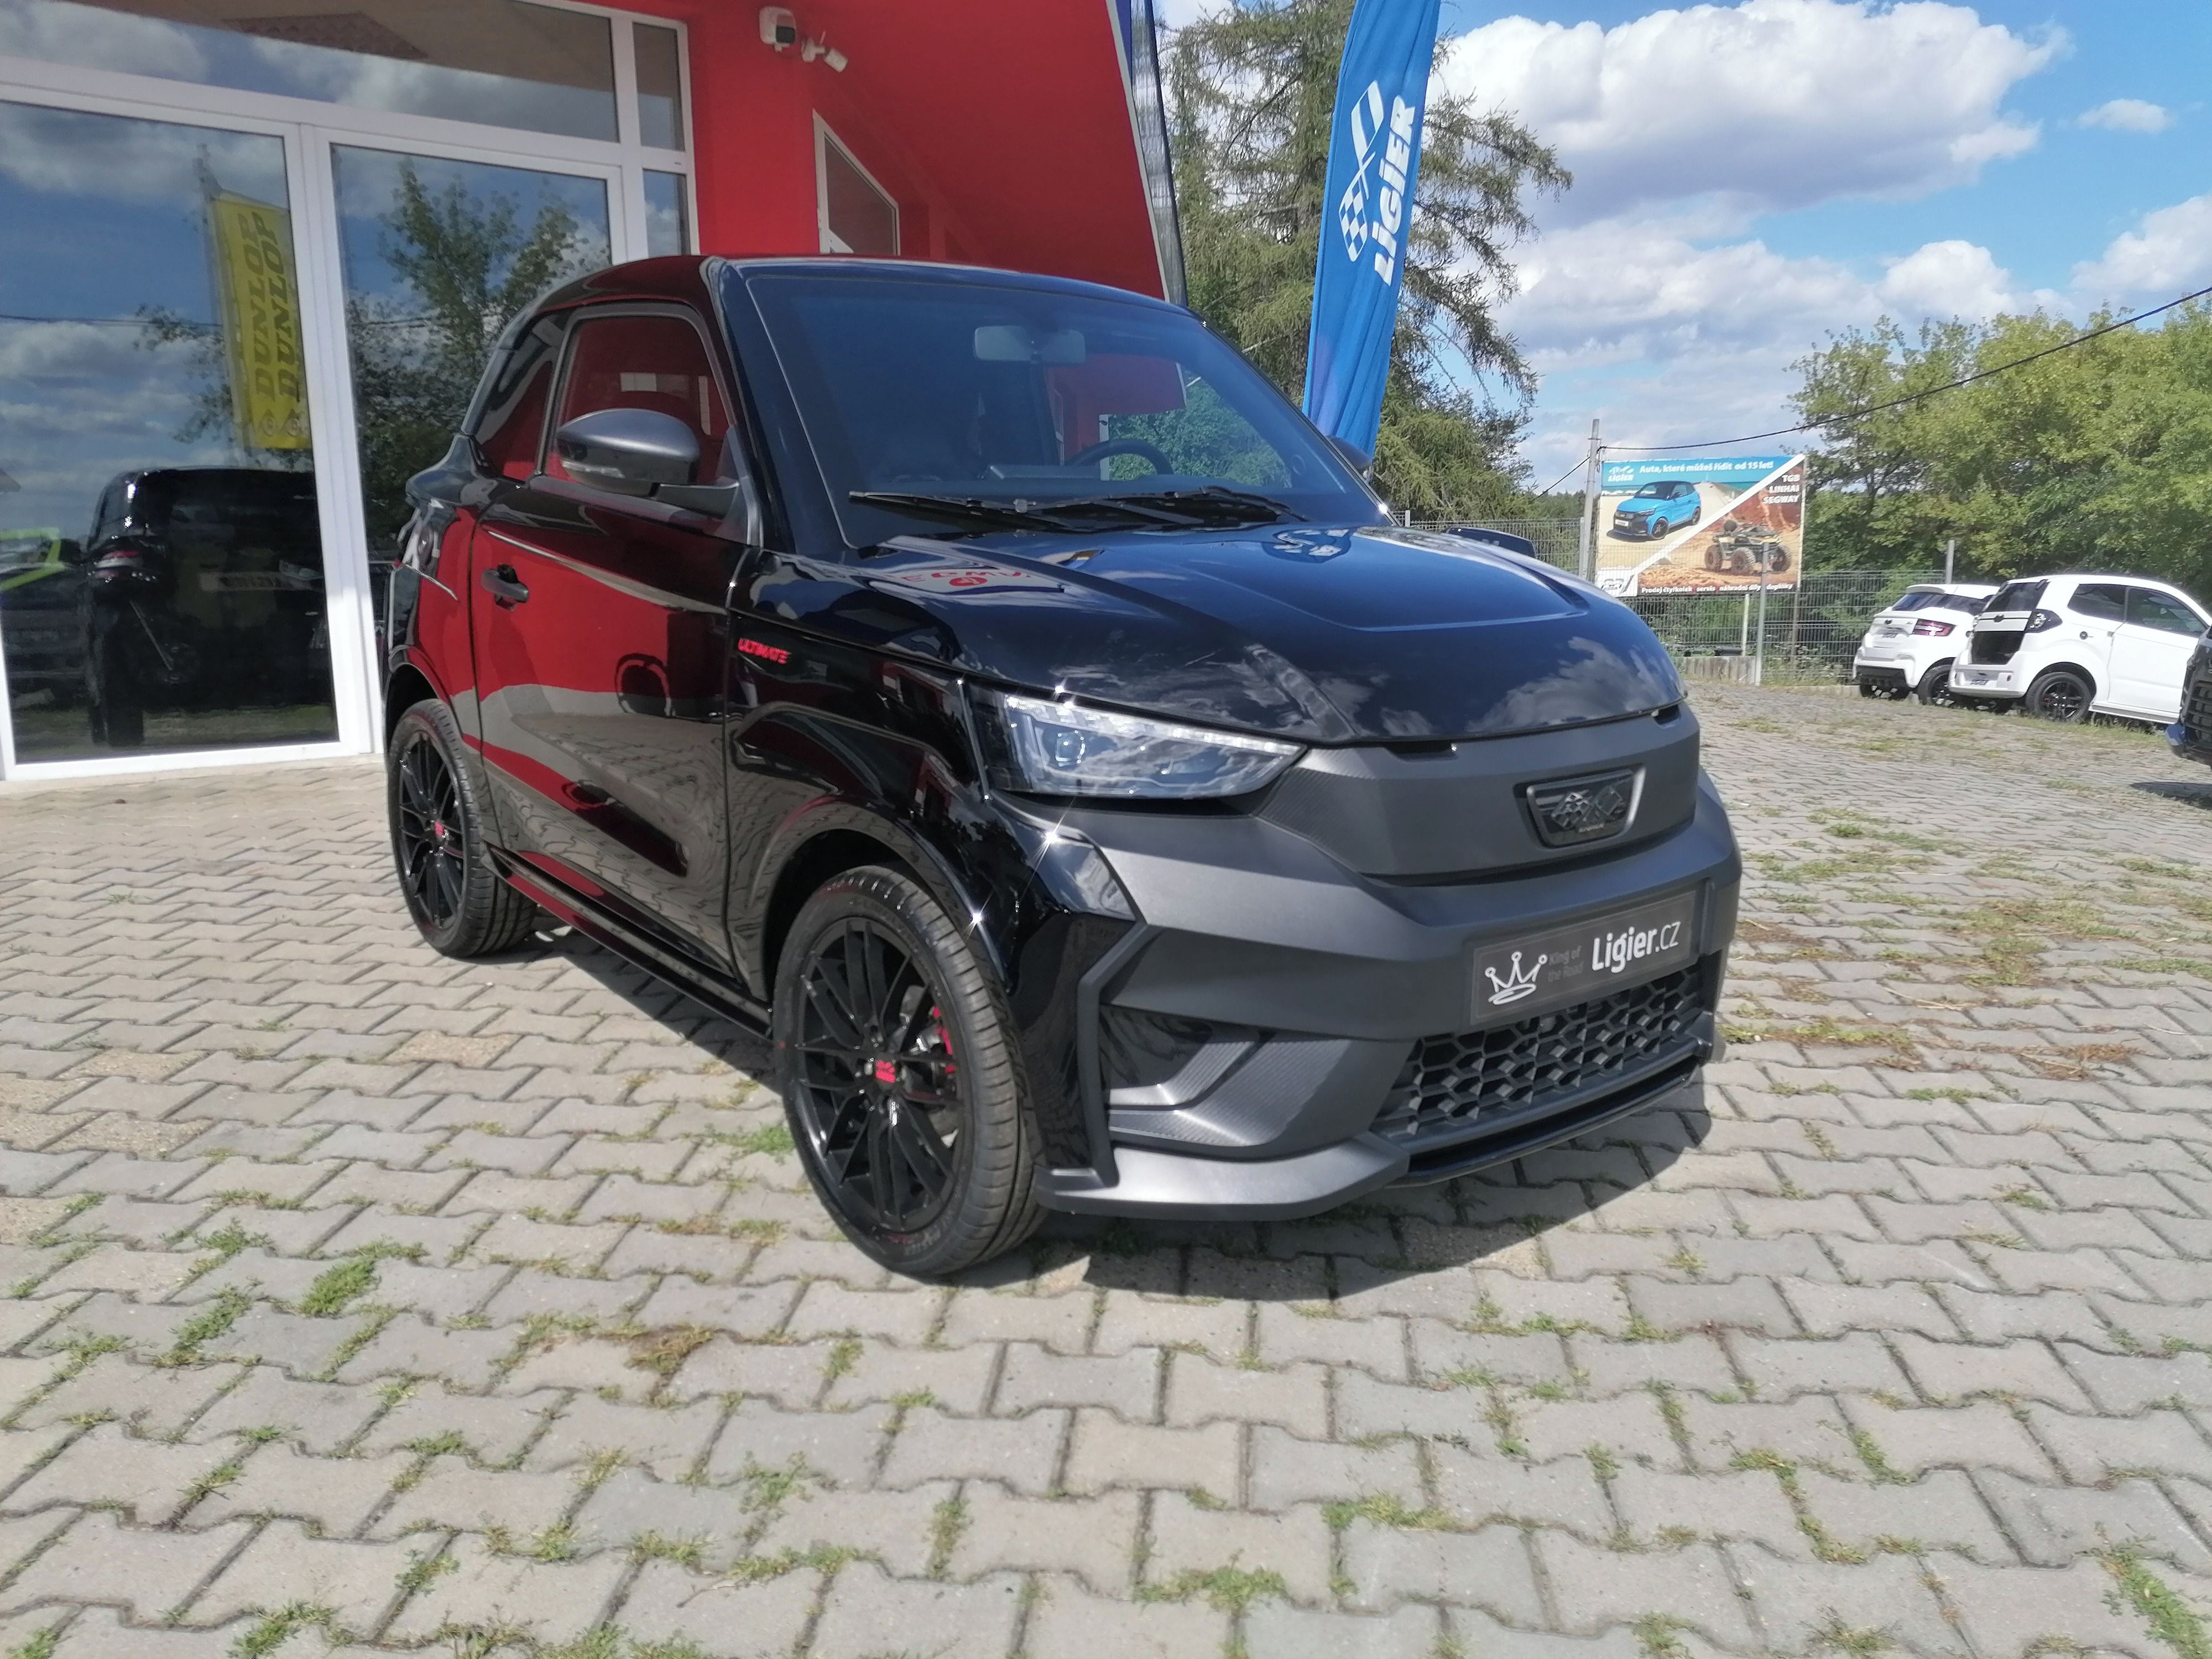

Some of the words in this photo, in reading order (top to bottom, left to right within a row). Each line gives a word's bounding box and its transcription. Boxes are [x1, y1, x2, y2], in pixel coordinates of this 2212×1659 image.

[237, 212, 275, 402] DUNLOP
[252, 211, 300, 403] DUNLOP
[1663, 464, 1686, 472] které
[1734, 461, 1746, 469] od
[1747, 461, 1759, 469] 15
[1762, 495, 1799, 504] SEGWAY
